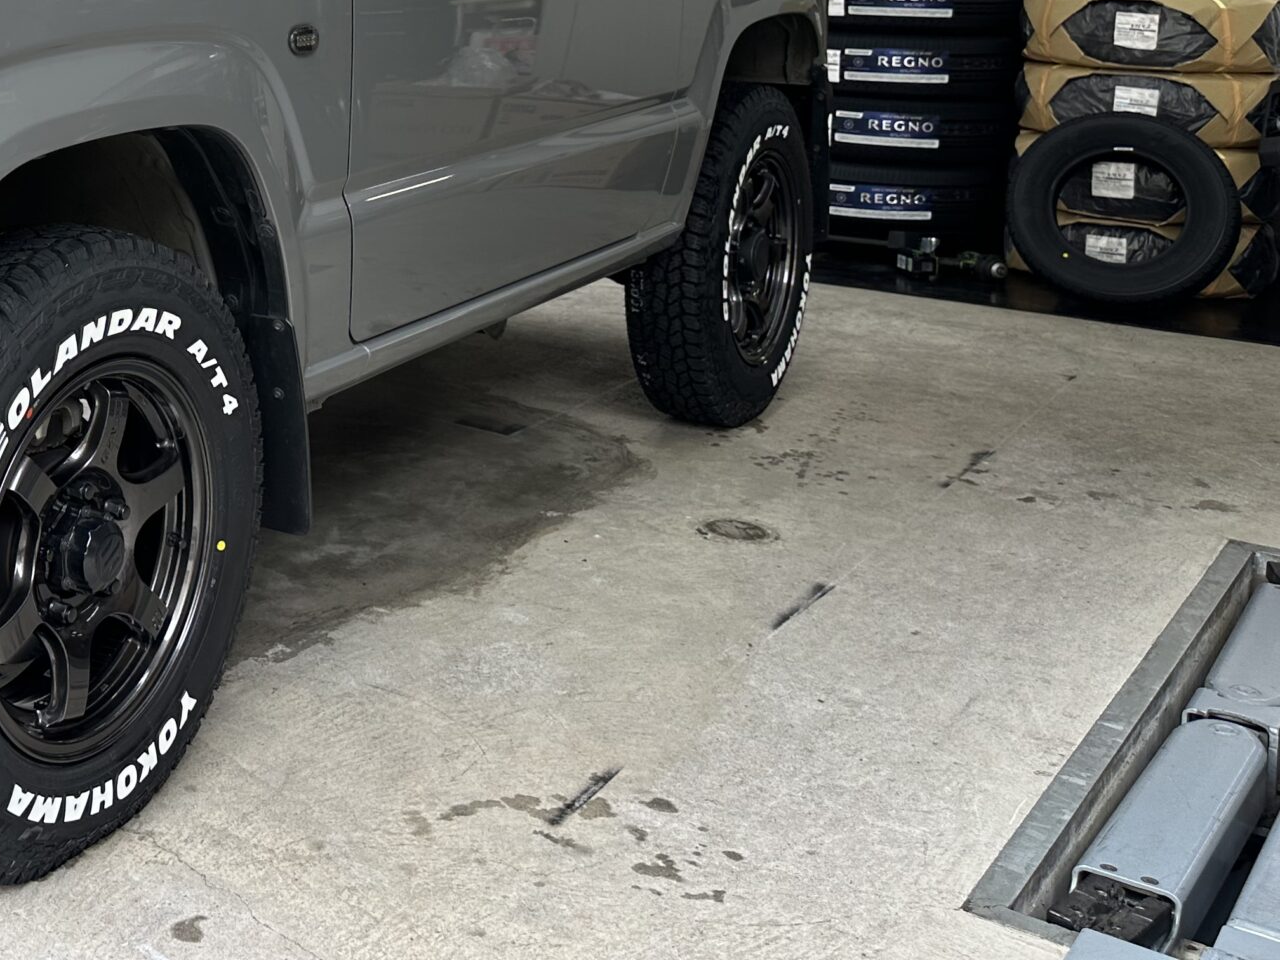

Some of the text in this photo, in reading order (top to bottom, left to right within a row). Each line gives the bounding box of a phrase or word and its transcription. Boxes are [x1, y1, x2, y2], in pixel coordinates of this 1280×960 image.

[877, 56, 943, 68] REGNO
[868, 119, 934, 133] REGNO
[860, 192, 926, 205] REGNO
[770, 253, 813, 388] YOKOHAMA
[5, 690, 198, 824] YOKOHAMA
